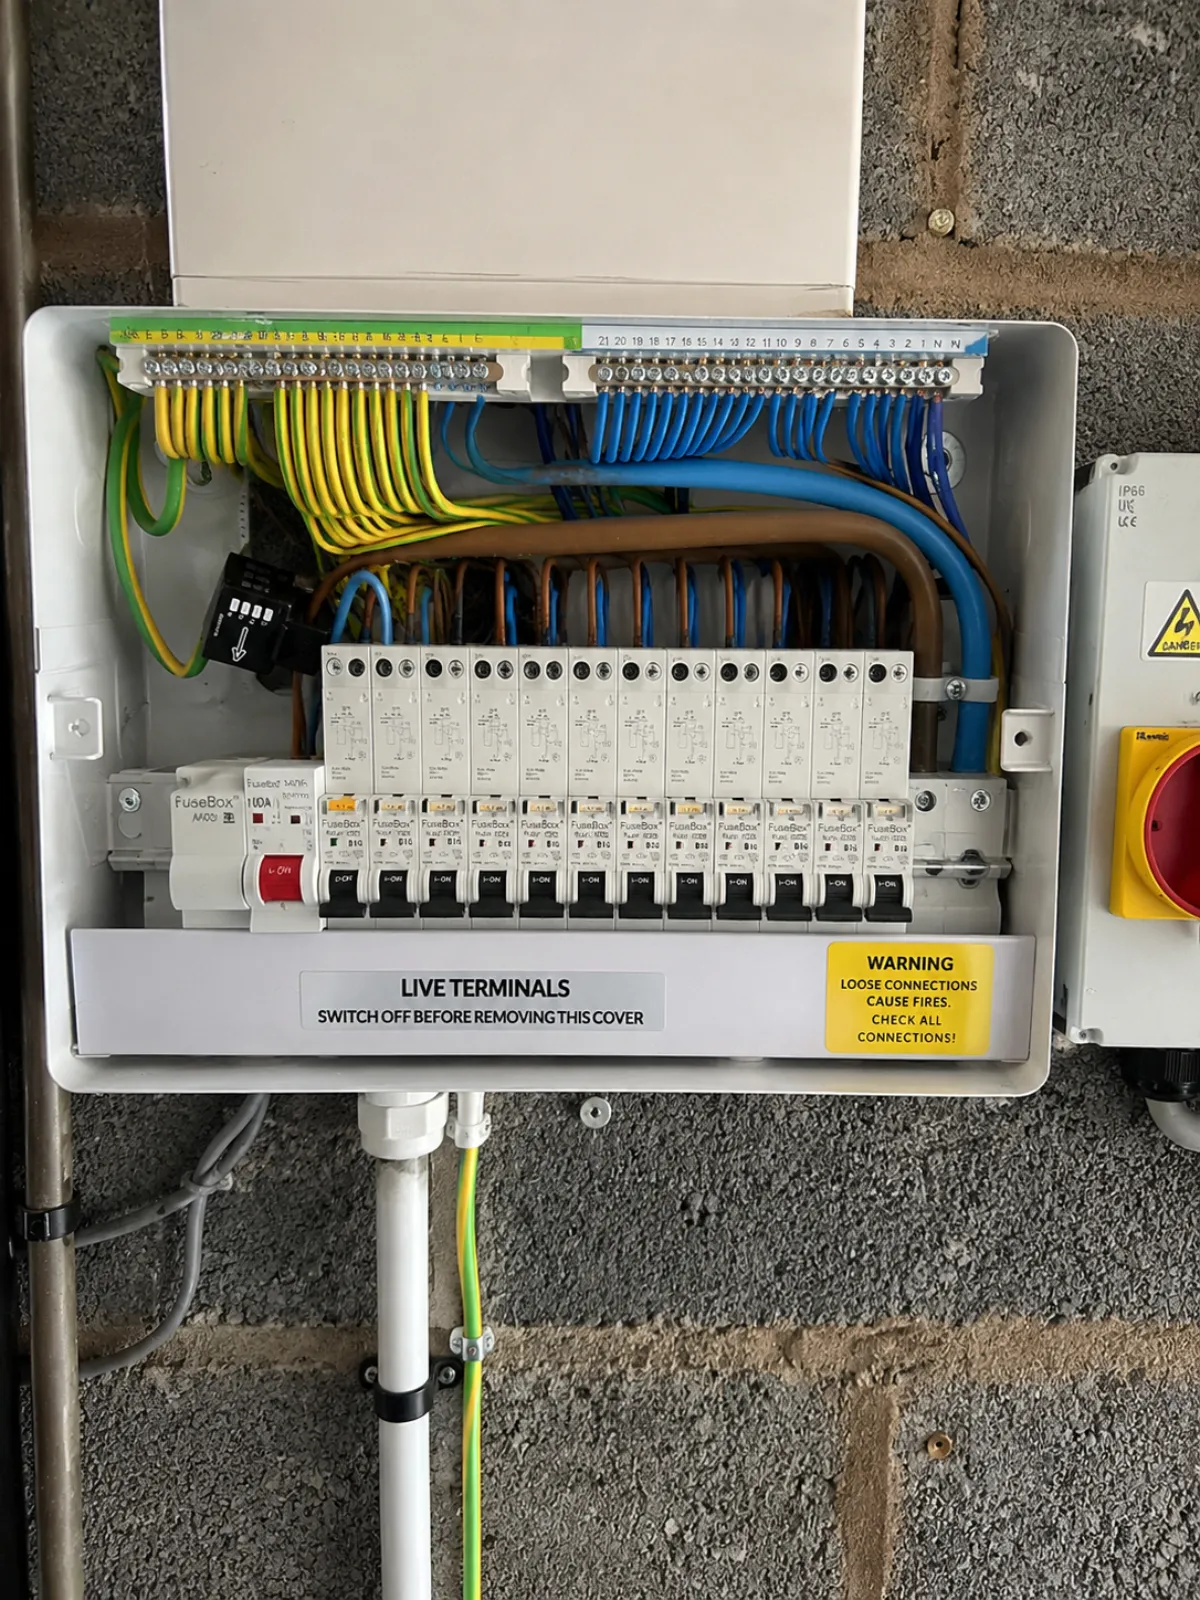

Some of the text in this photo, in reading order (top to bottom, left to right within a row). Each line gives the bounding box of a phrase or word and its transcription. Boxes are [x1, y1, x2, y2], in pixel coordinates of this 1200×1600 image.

[598, 336, 609, 346] 21
[614, 336, 626, 346] 20
[632, 336, 643, 346] 19
[650, 336, 660, 346] 18
[666, 337, 676, 346] 17
[682, 337, 692, 346] 16
[713, 338, 723, 346] 14
[777, 338, 787, 347] 10
[934, 340, 942, 348] N
[1118, 485, 1145, 496] IP66
[176, 796, 234, 808] FuseBox
[868, 956, 954, 971] WARNING
[402, 978, 570, 998] LIVE TERMINALS
[841, 979, 978, 991] LOOSE CONNECTIONS
[866, 996, 951, 1008] CAUSE FIRES.
[318, 1010, 644, 1025] SWITCH OFF BEFORE REMOVING THIS COVER
[872, 1015, 942, 1025] CHECK ALL
[858, 1032, 956, 1043] CONNECTIONS!
